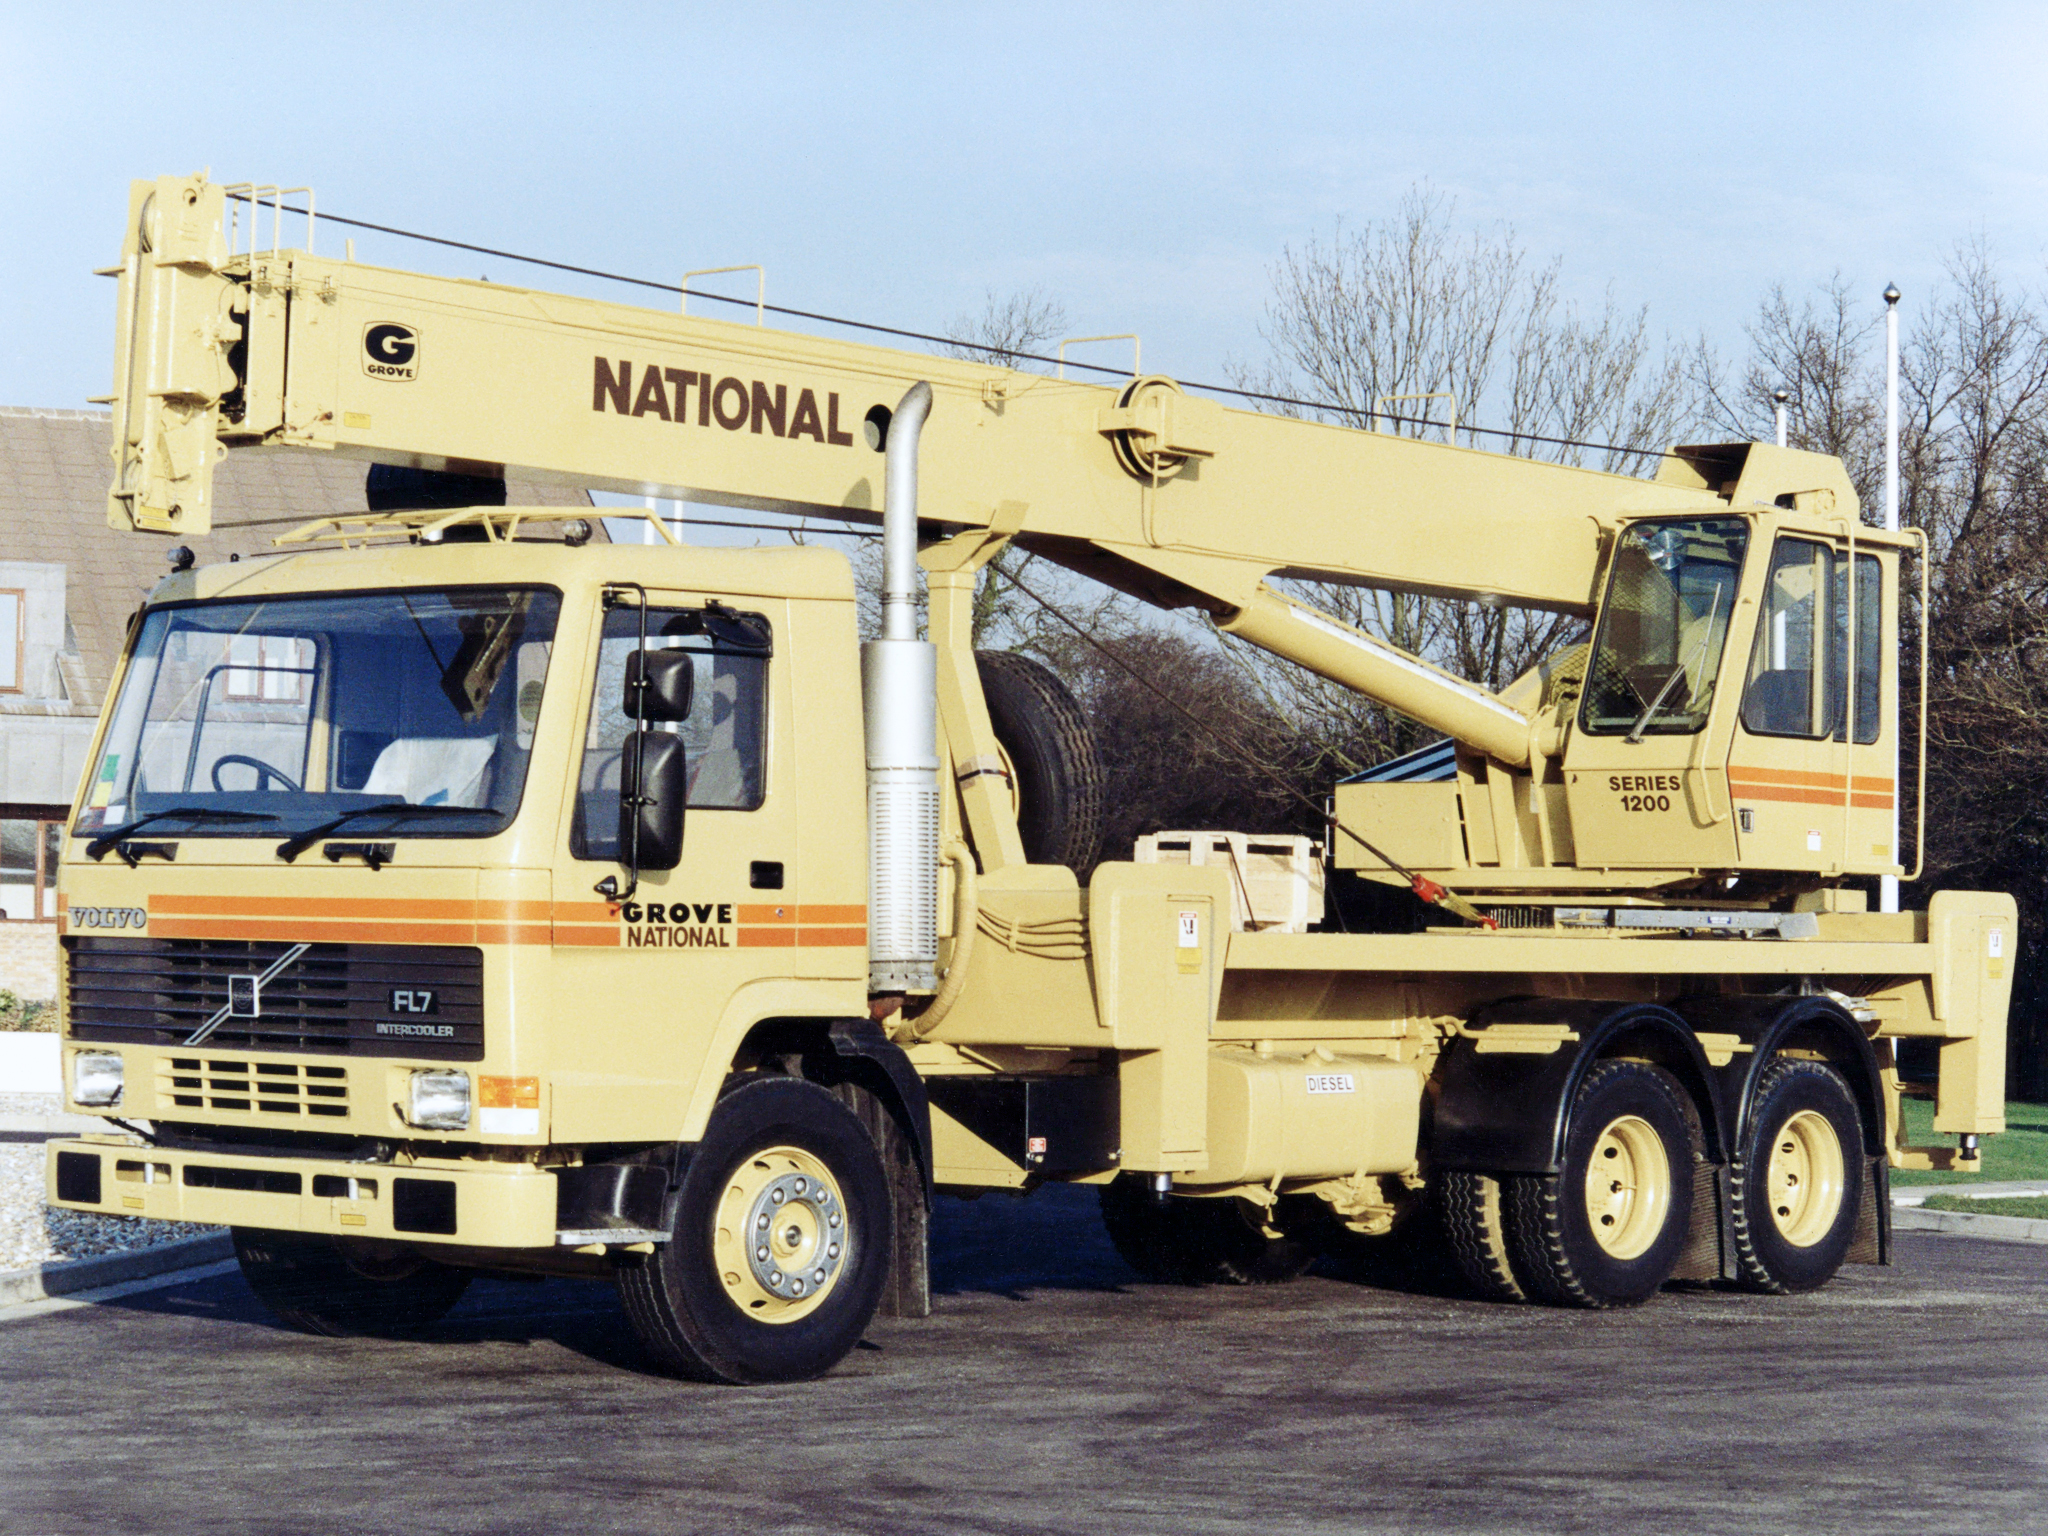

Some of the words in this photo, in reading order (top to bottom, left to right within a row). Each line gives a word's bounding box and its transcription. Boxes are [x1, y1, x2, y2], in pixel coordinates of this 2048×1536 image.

[368, 364, 413, 378] GROVE
[593, 356, 853, 447] NATIONAL
[1609, 776, 1681, 791] SERIES
[1621, 795, 1670, 812] 1200
[68, 907, 147, 929] VOLVO
[622, 902, 732, 923] GROVE
[627, 926, 730, 947] NATIONAL
[394, 990, 432, 1012] FL7
[376, 1023, 454, 1037] INTERCOOLER
[1308, 1077, 1352, 1091] DIESEL
